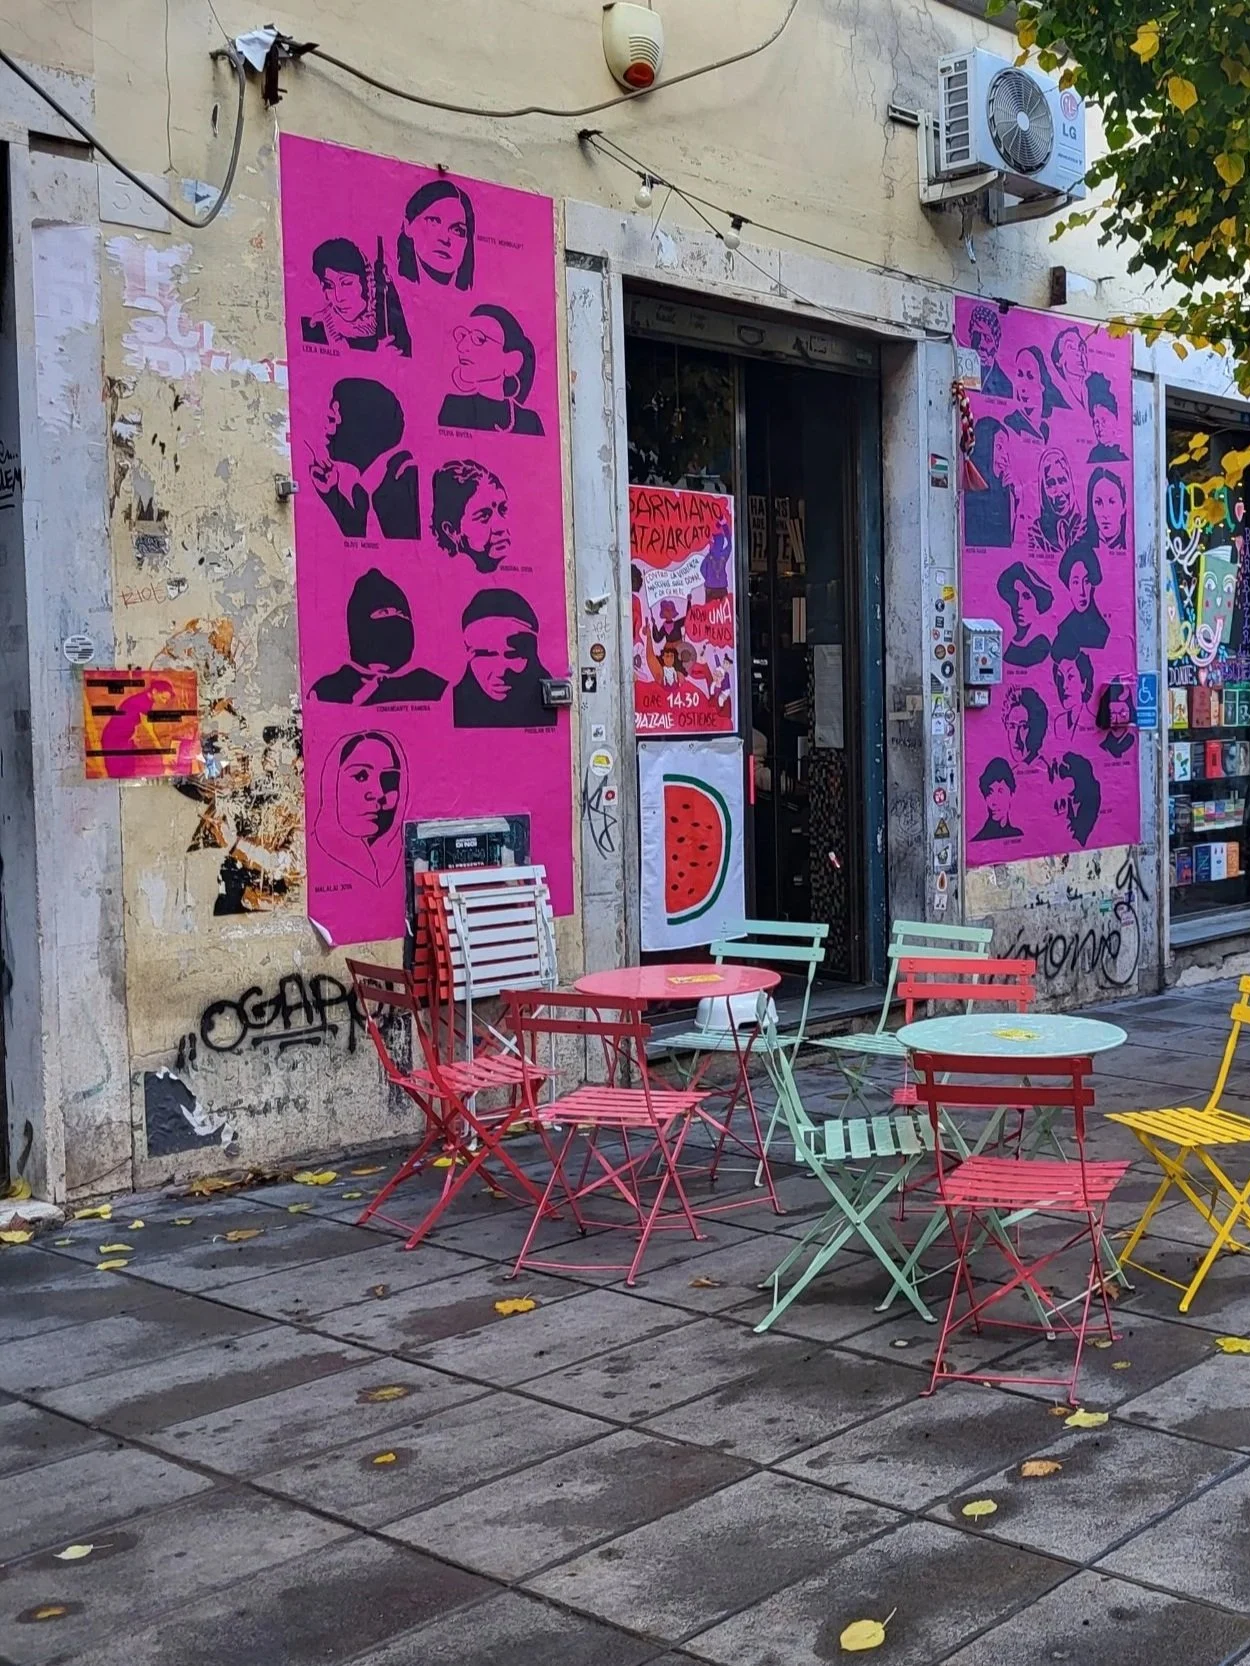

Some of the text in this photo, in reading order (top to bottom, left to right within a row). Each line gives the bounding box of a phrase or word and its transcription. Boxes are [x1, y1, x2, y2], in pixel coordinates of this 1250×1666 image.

[1062, 122, 1077, 140] LG
[708, 600, 732, 624] UNA
[705, 626, 732, 641] MENO
[666, 692, 700, 708] 14.30
